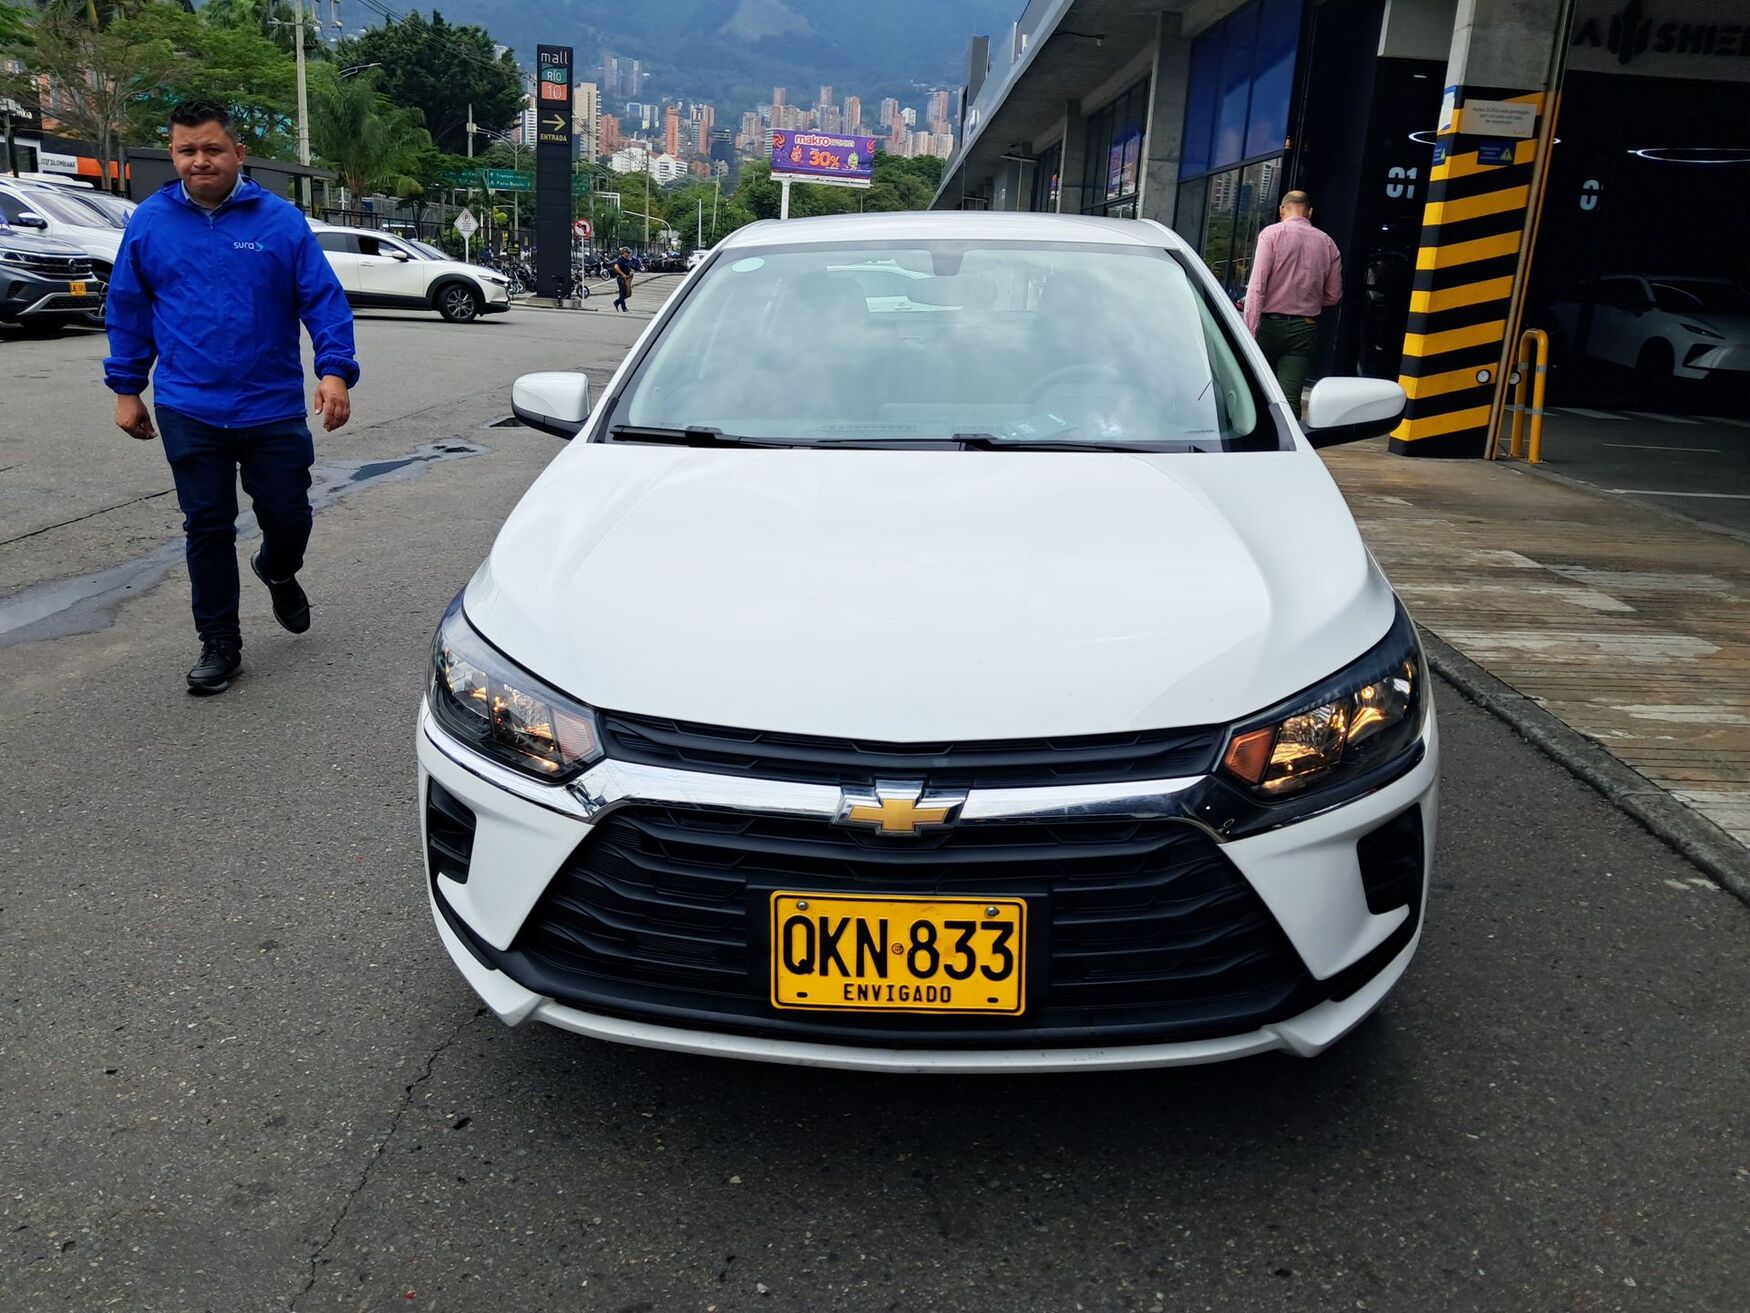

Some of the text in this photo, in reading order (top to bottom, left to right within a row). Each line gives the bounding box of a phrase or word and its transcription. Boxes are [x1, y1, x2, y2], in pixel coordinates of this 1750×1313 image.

[1653, 22, 1750, 57] SHIE
[541, 51, 568, 64] mall
[547, 85, 562, 99] 10
[540, 133, 568, 142] ENTRADA
[809, 151, 840, 168] 30%
[1386, 166, 1418, 199] 01
[233, 241, 255, 250] sura
[783, 915, 1015, 982] QKN 833
[843, 983, 952, 1004] ENVIGADO
